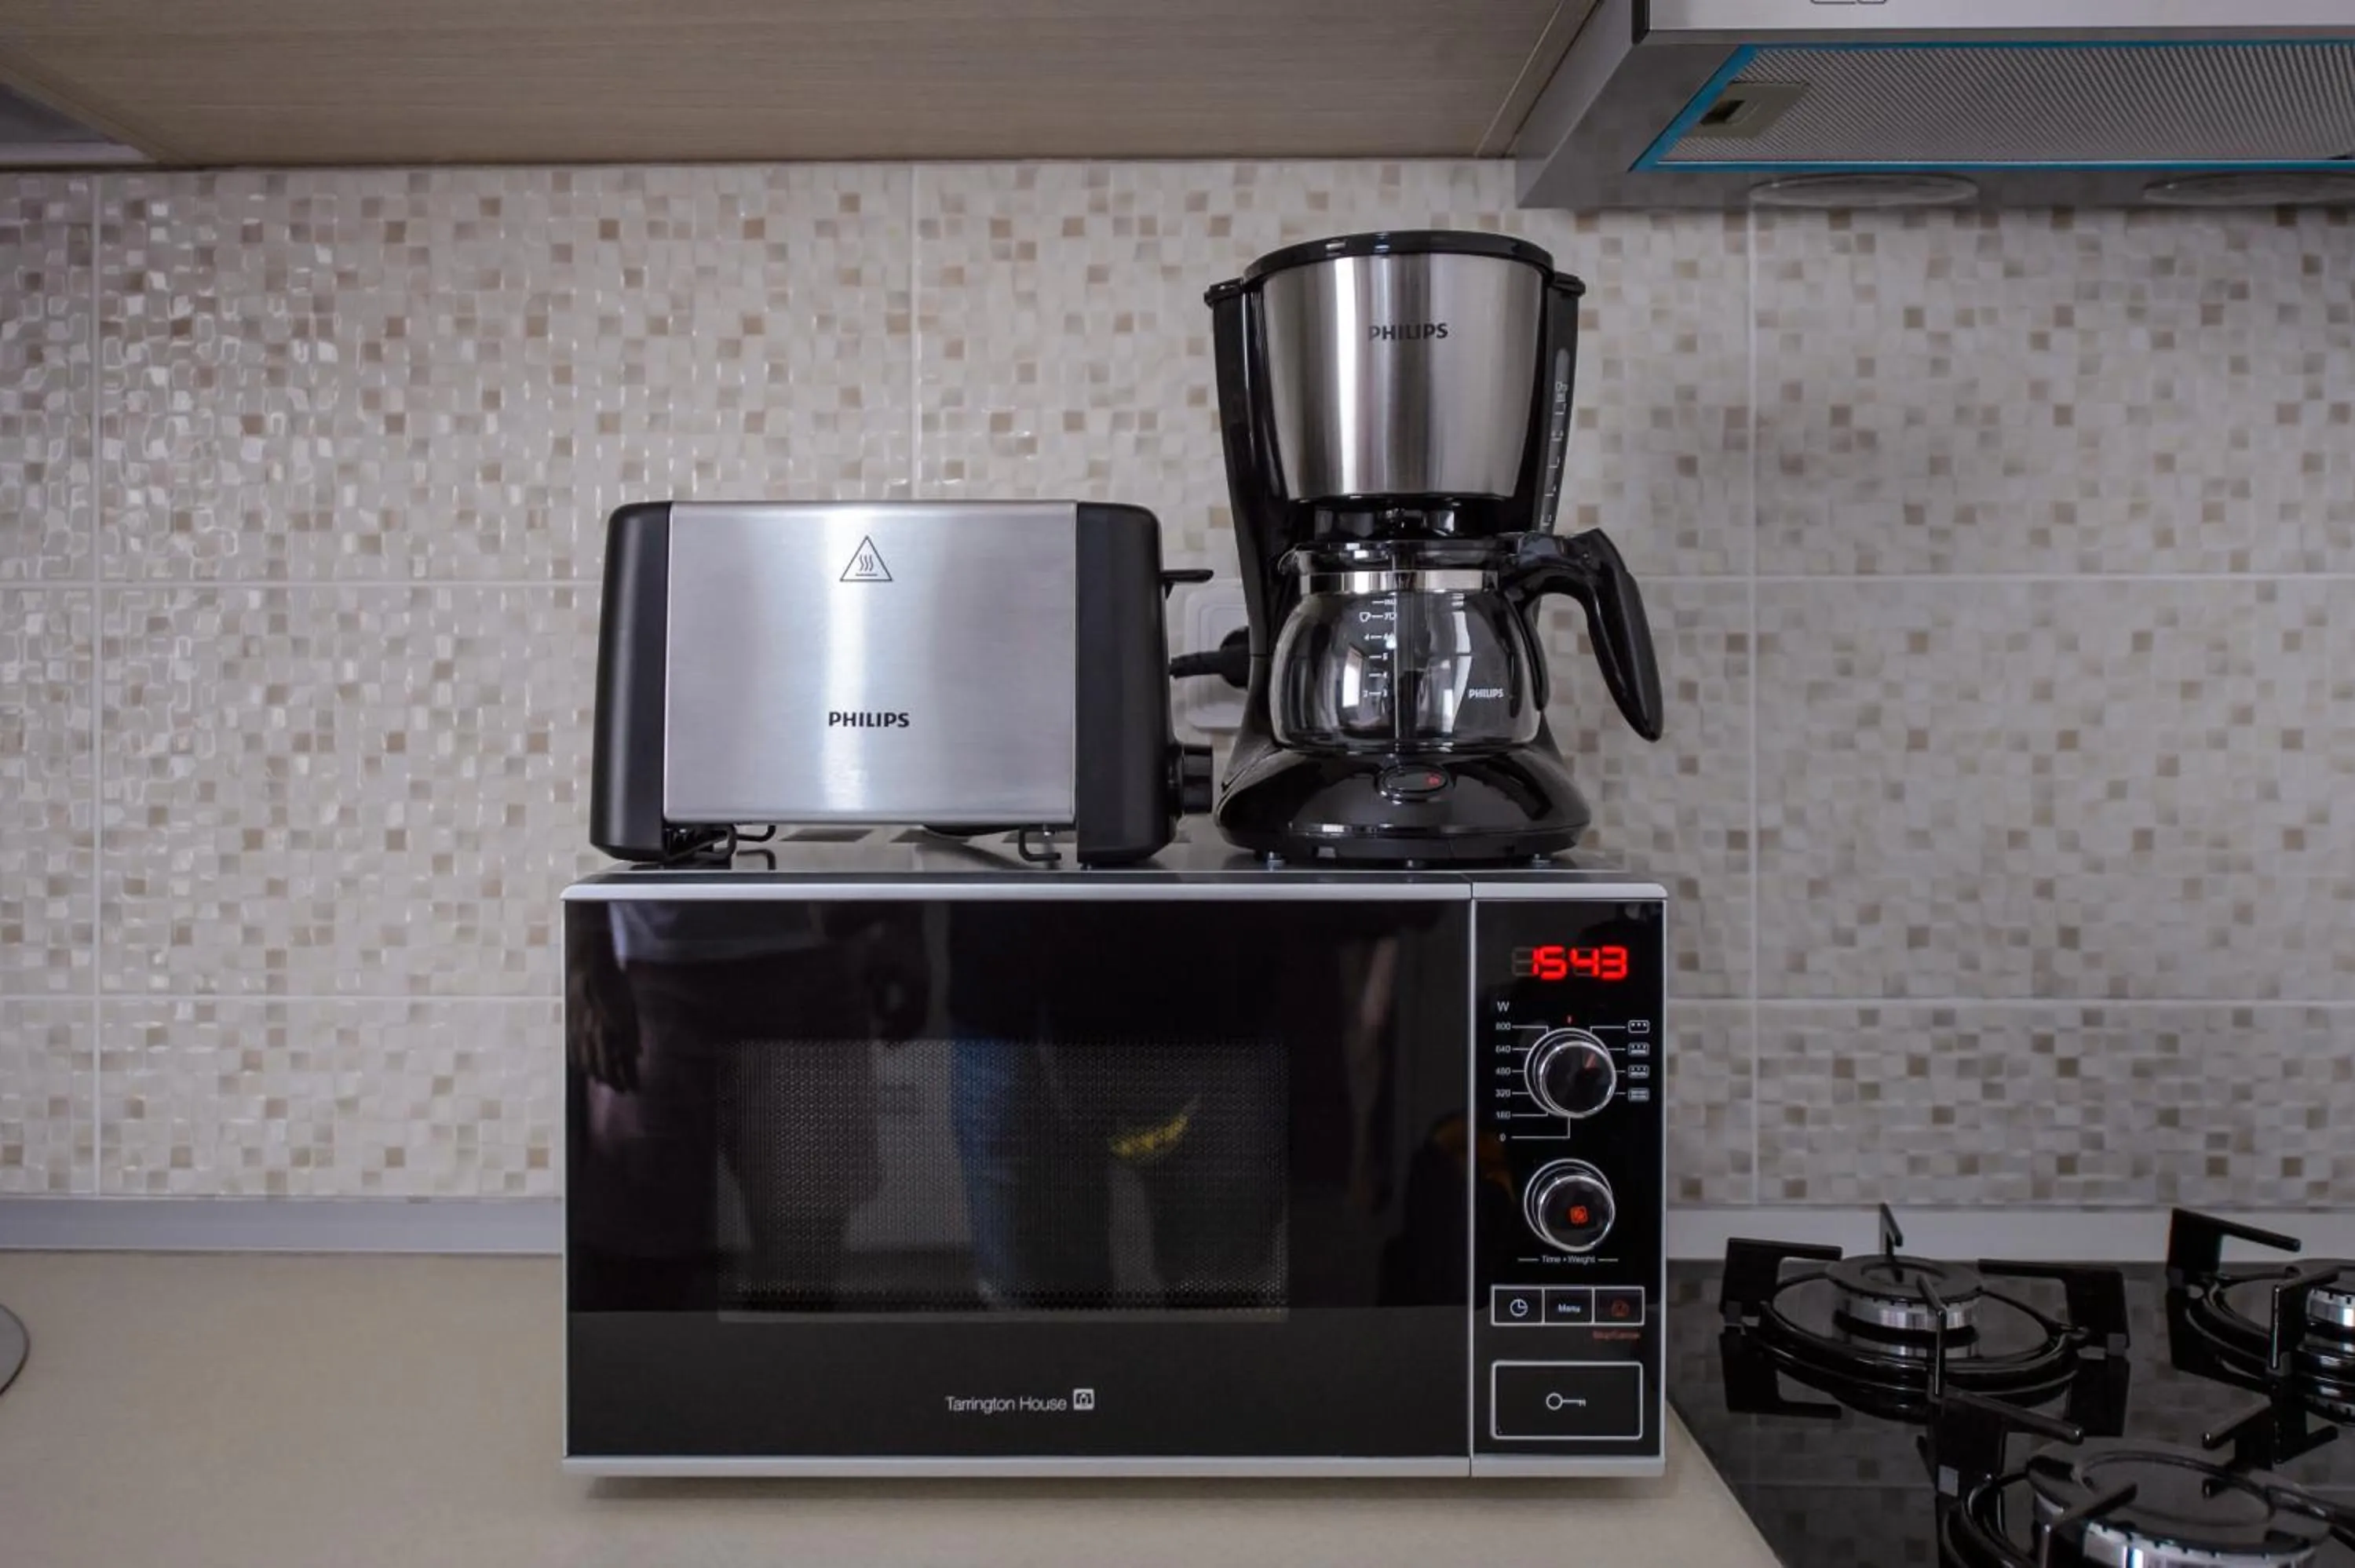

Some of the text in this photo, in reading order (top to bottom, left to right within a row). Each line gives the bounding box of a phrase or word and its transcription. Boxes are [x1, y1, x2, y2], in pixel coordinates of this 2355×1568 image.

[1368, 323, 1448, 340] PHILIPS
[1469, 688, 1503, 698] PHILIPS
[829, 712, 910, 727] PHILIPS
[1497, 1001, 1510, 1012] W
[1558, 1304, 1580, 1313] Menu
[945, 1396, 1067, 1413] Tarrington House
